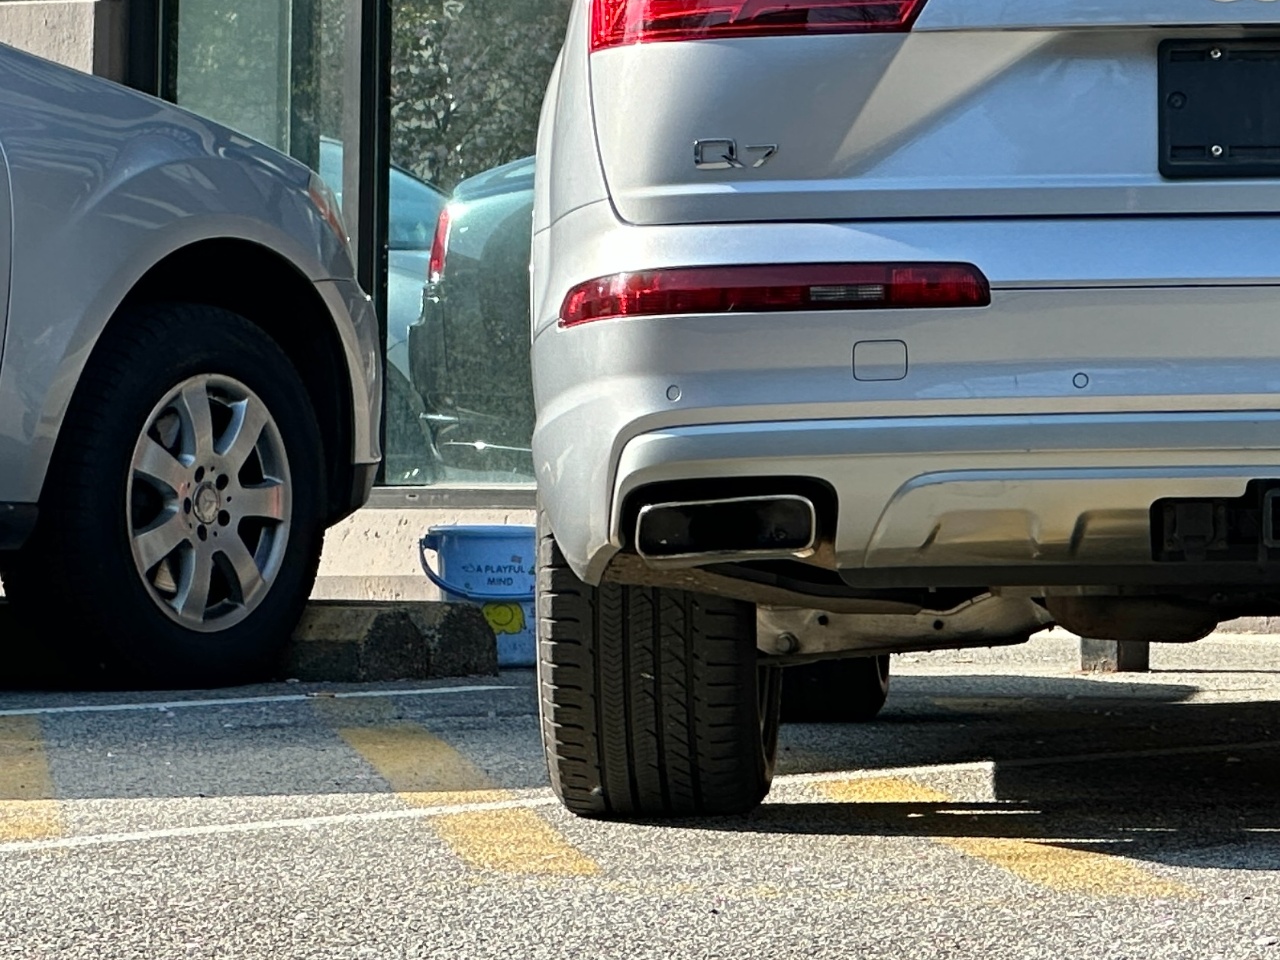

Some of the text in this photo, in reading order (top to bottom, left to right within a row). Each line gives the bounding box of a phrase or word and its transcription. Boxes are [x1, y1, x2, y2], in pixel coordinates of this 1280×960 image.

[693, 138, 779, 170] Q7
[476, 564, 525, 574] A PLAYFUL
[487, 577, 514, 586] MIND
